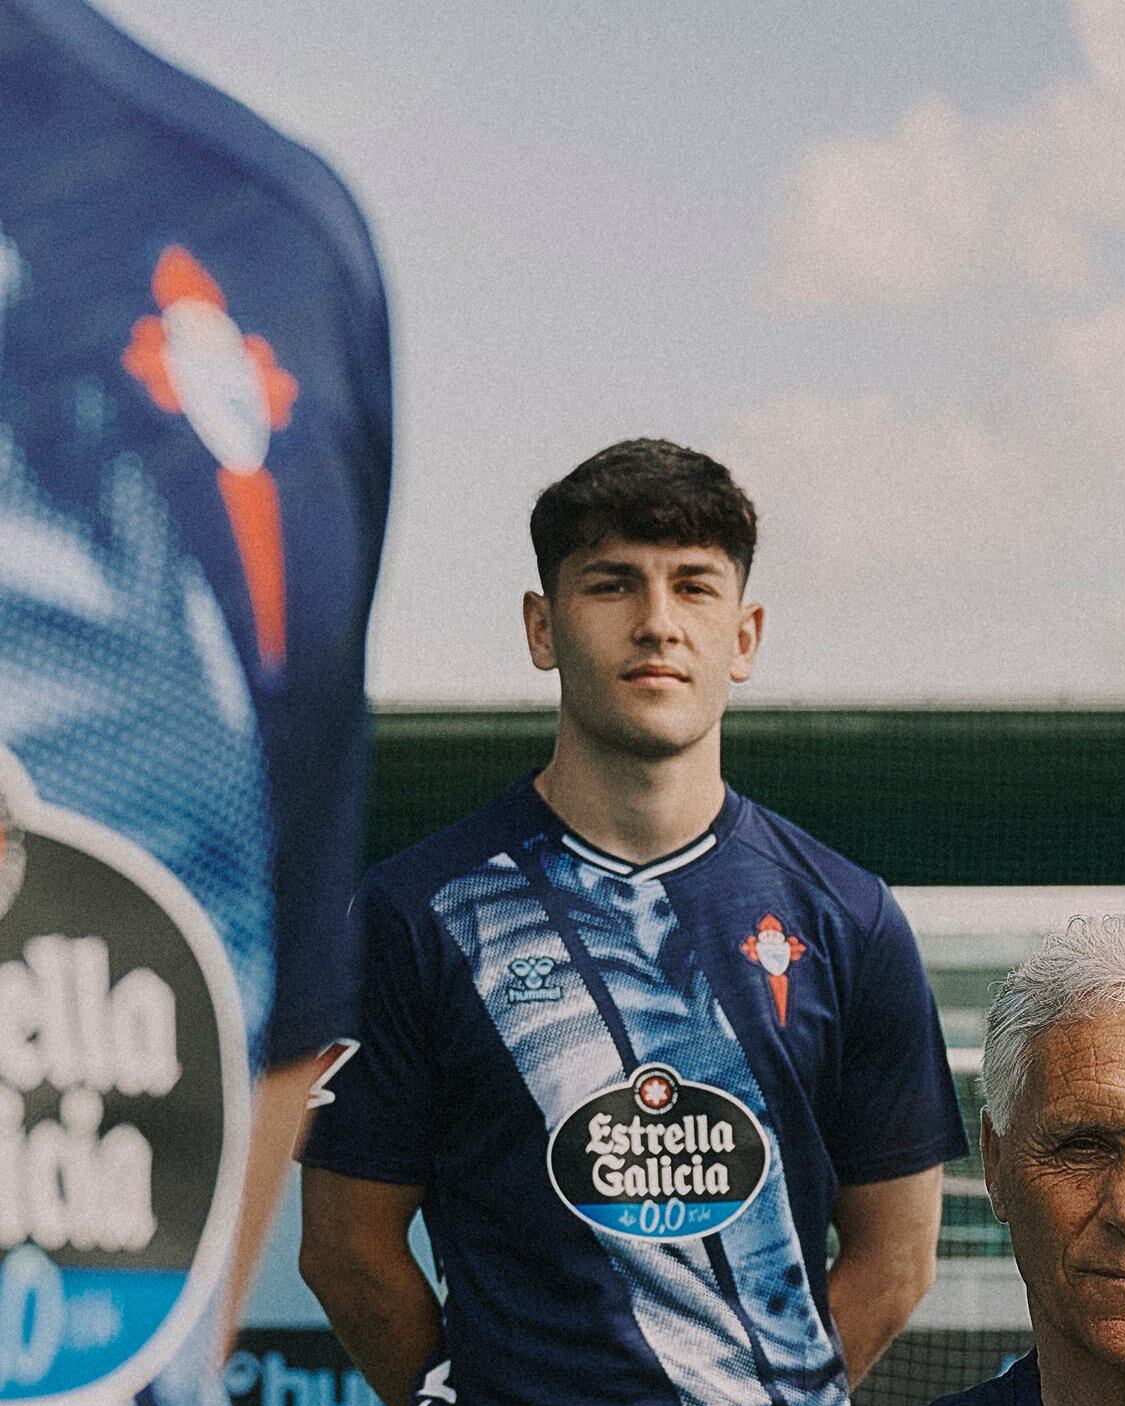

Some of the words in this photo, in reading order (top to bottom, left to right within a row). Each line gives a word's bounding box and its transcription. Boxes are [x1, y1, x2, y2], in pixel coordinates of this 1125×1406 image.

[585, 1112, 736, 1156] Estrella
[592, 1154, 731, 1197] Galicia
[639, 1197, 686, 1234] 0,0
